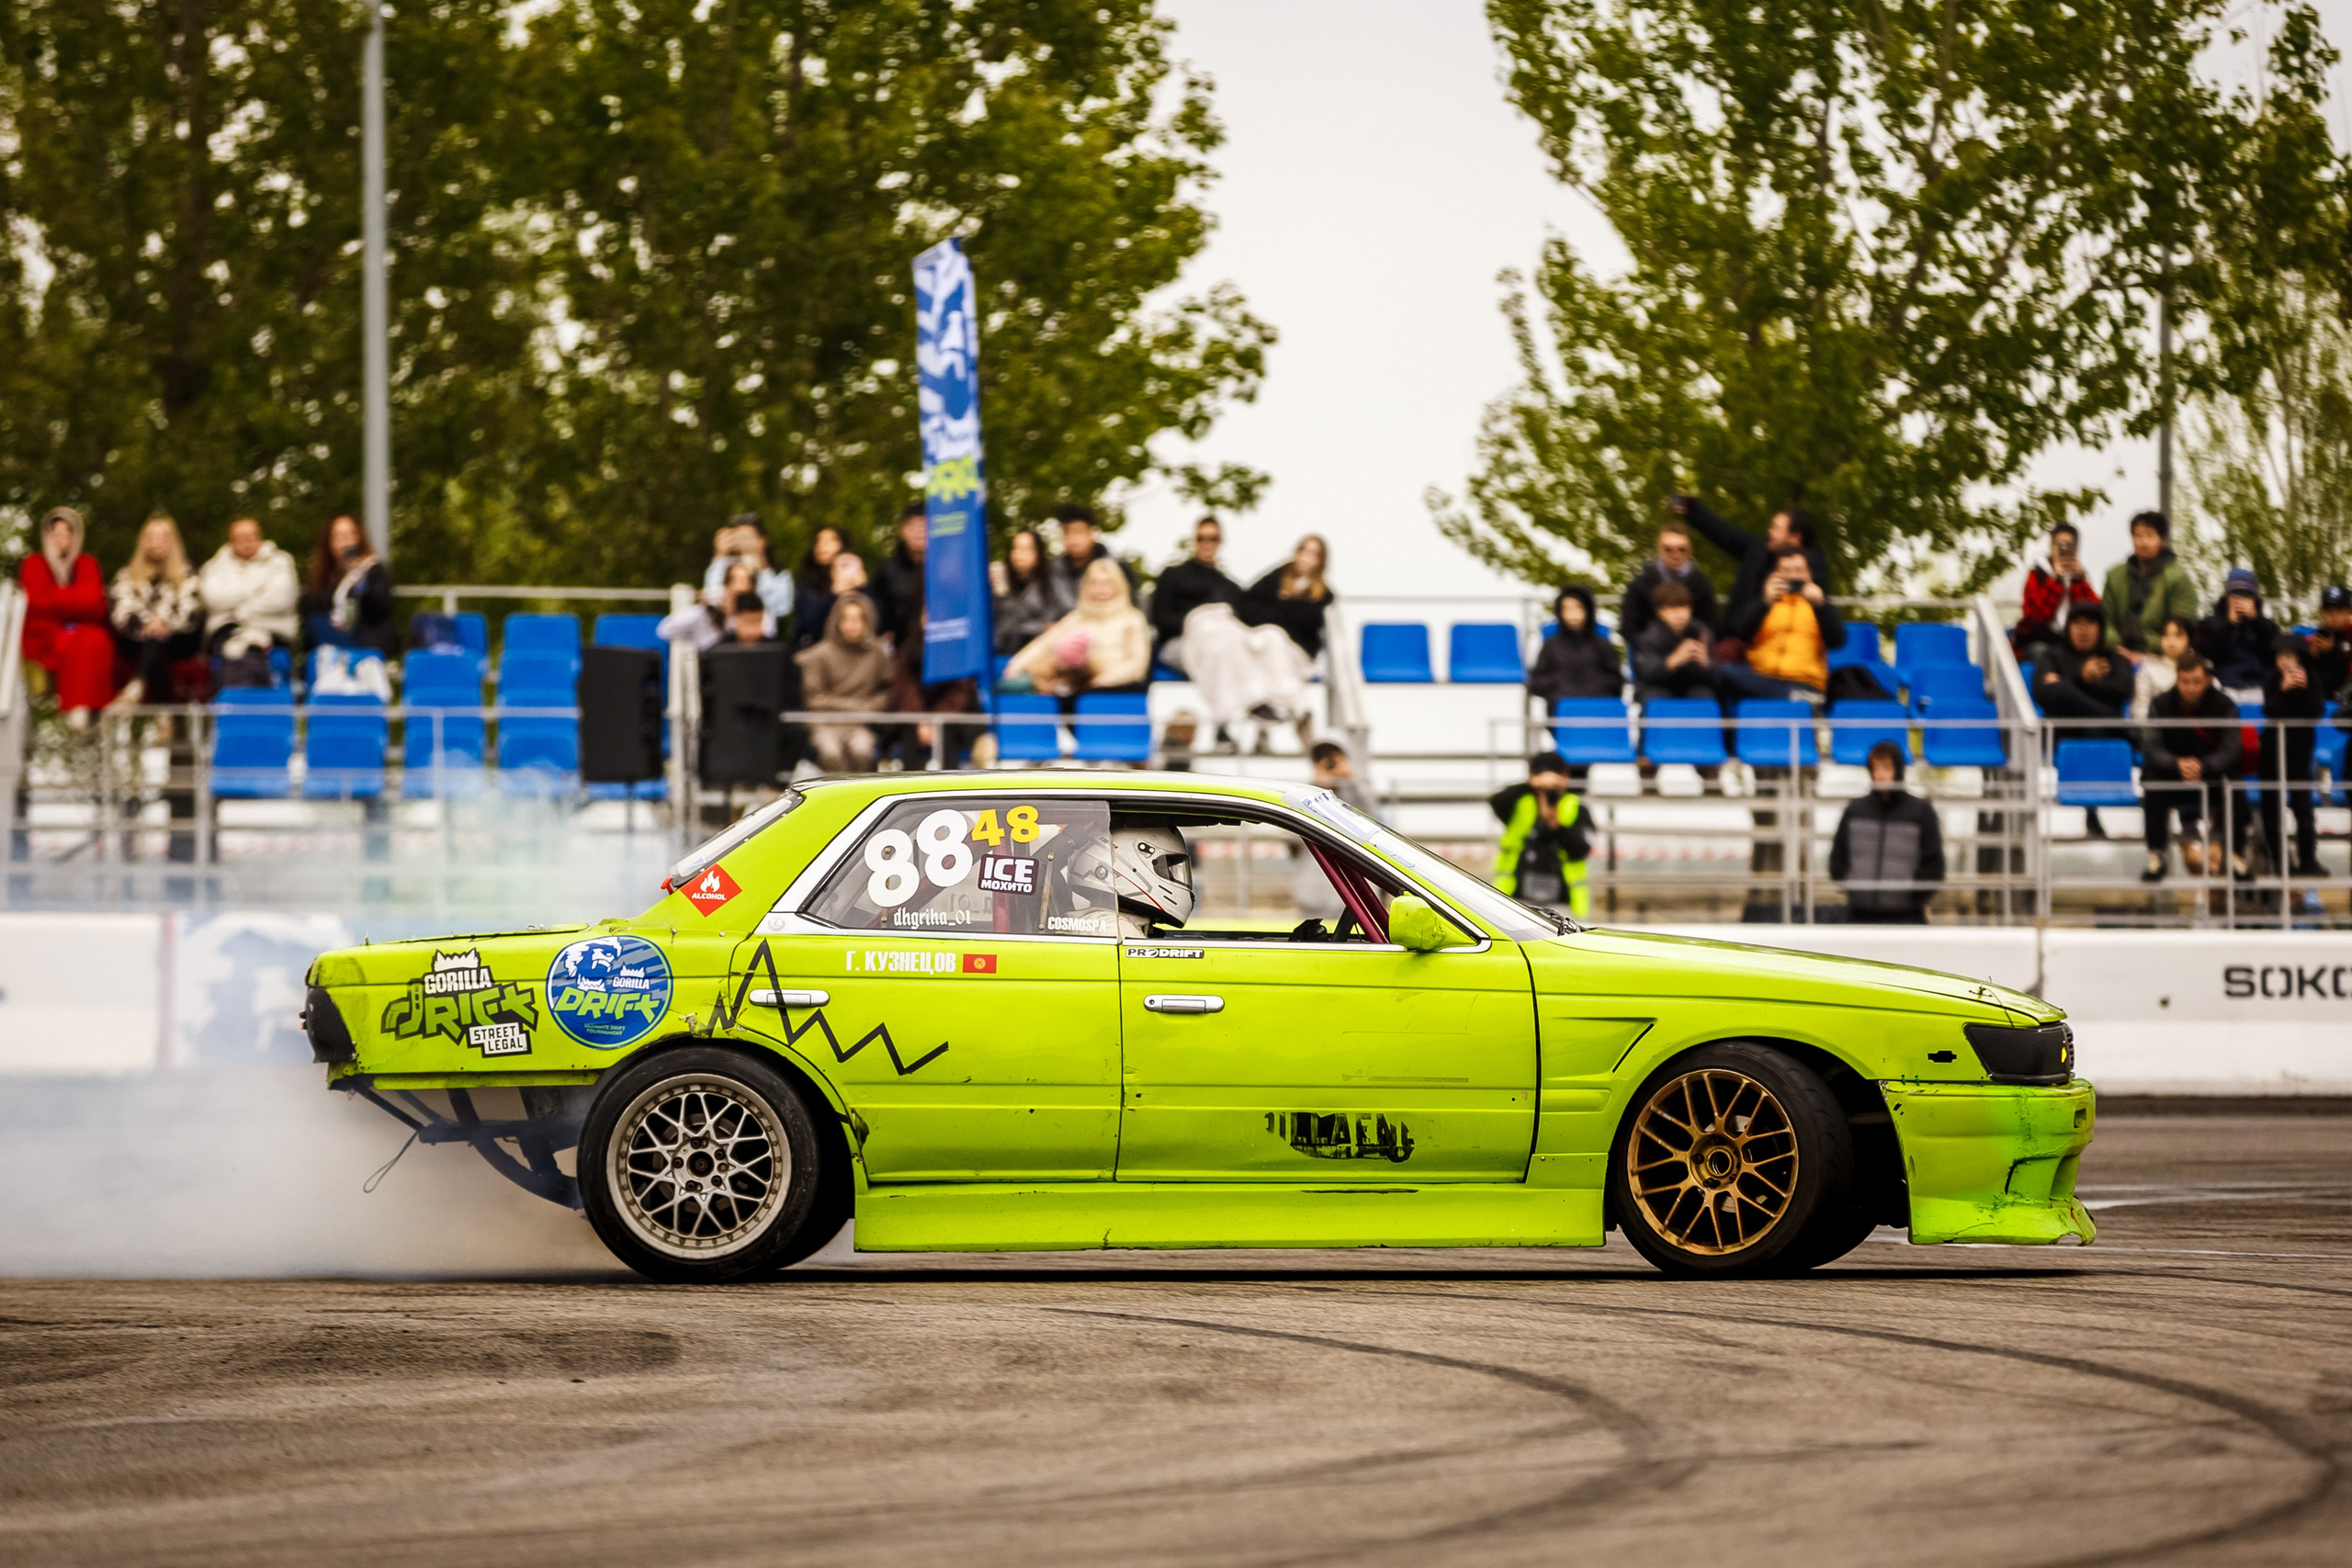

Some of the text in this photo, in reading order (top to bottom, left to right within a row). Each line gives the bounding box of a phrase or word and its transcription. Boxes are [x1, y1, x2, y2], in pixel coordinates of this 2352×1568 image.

[971, 806, 1040, 847] 48
[984, 857, 1035, 883] ICE
[980, 879, 1033, 893] МОХИТО
[692, 892, 727, 900] ALCOHOL
[1047, 917, 1107, 932] COSMOSPA
[846, 951, 956, 975] Г. КУЗНЕЦОВ
[424, 968, 492, 994] GORILLA
[612, 976, 650, 989] GORILLA
[474, 1025, 516, 1041] STREET
[488, 1037, 524, 1052] LEGAL
